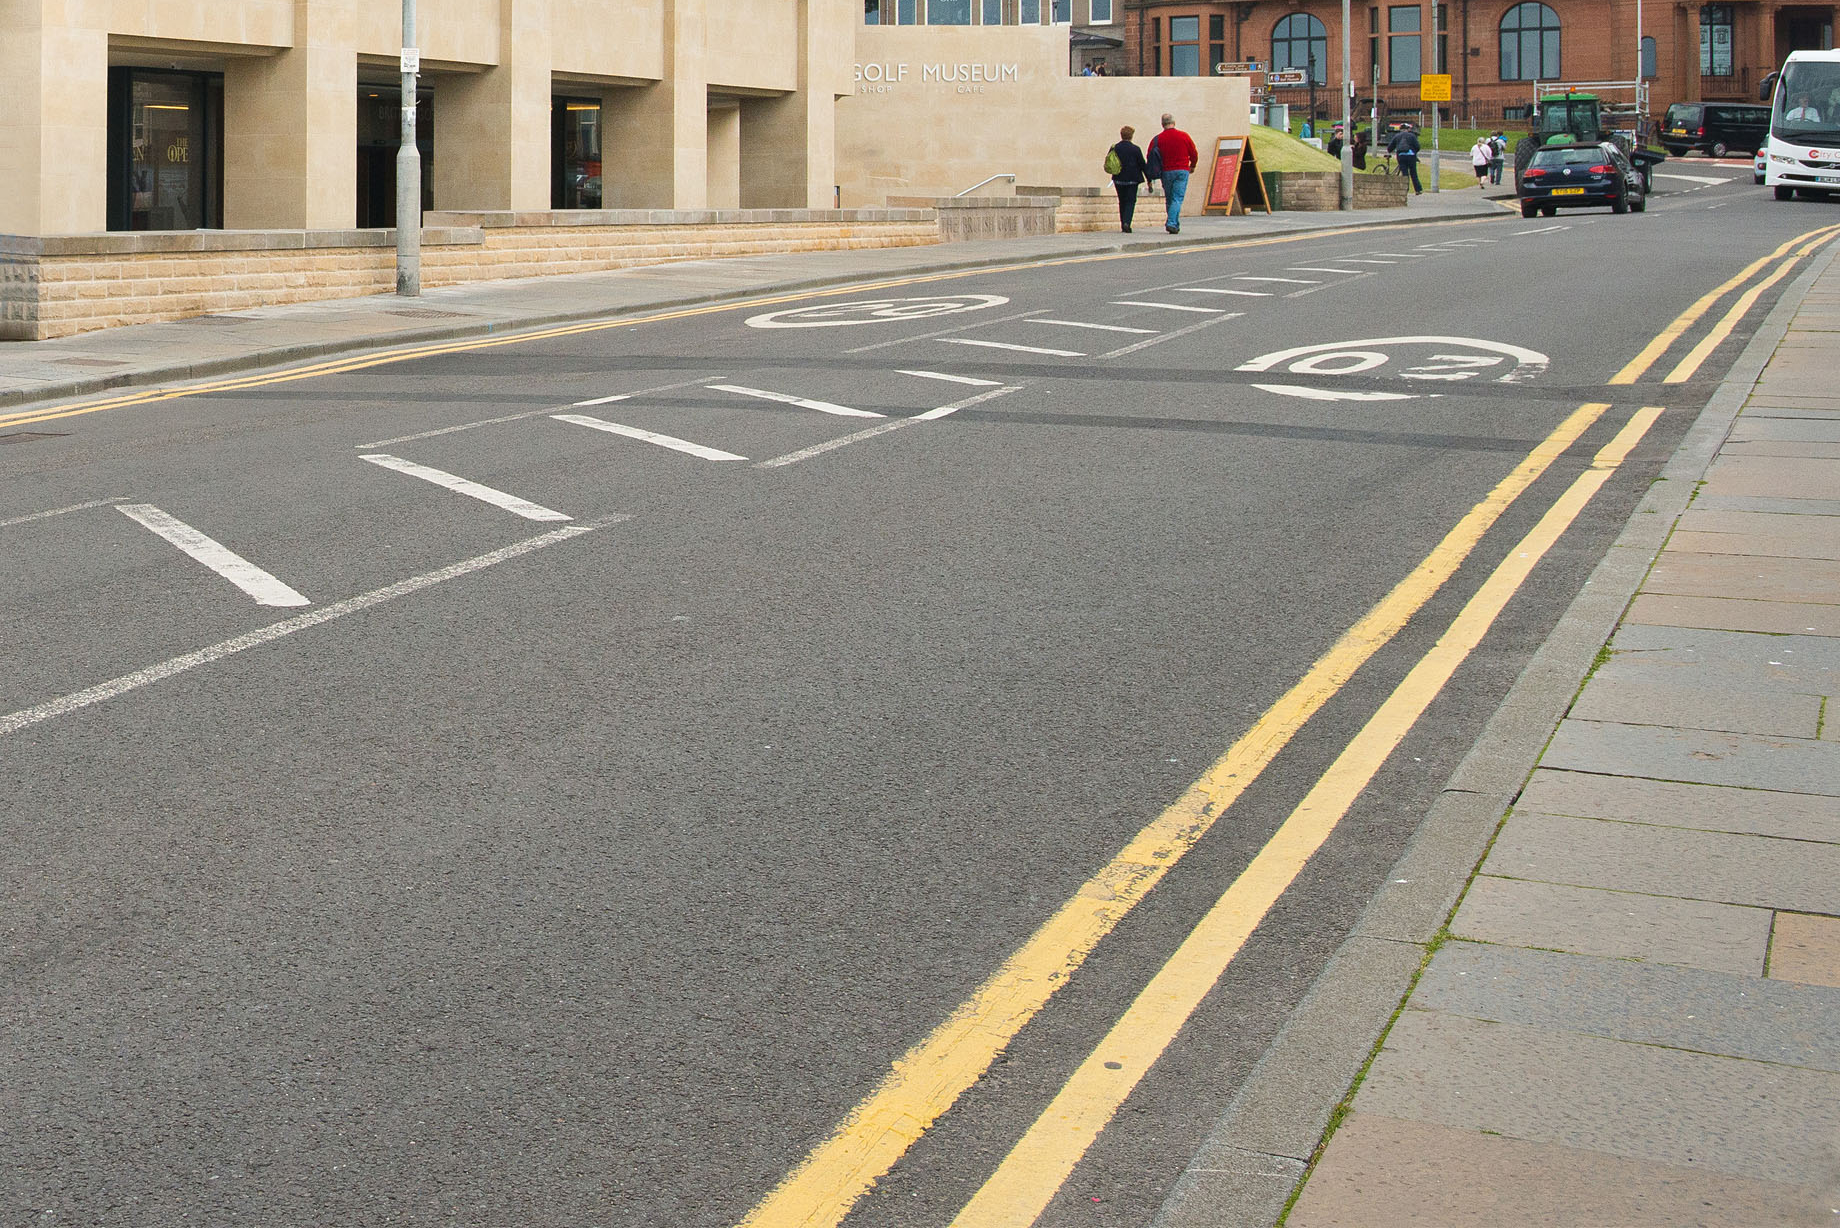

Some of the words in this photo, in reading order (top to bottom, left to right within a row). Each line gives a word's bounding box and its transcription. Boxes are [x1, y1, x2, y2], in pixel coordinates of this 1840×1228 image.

[922, 62, 1018, 82] MUSEUM
[861, 85, 892, 93] SHOP
[176, 137, 189, 147] THE
[1808, 149, 1832, 159] City
[941, 217, 959, 233] THE
[962, 216, 995, 233] BRITISH
[1022, 215, 1055, 232] MUSEUM
